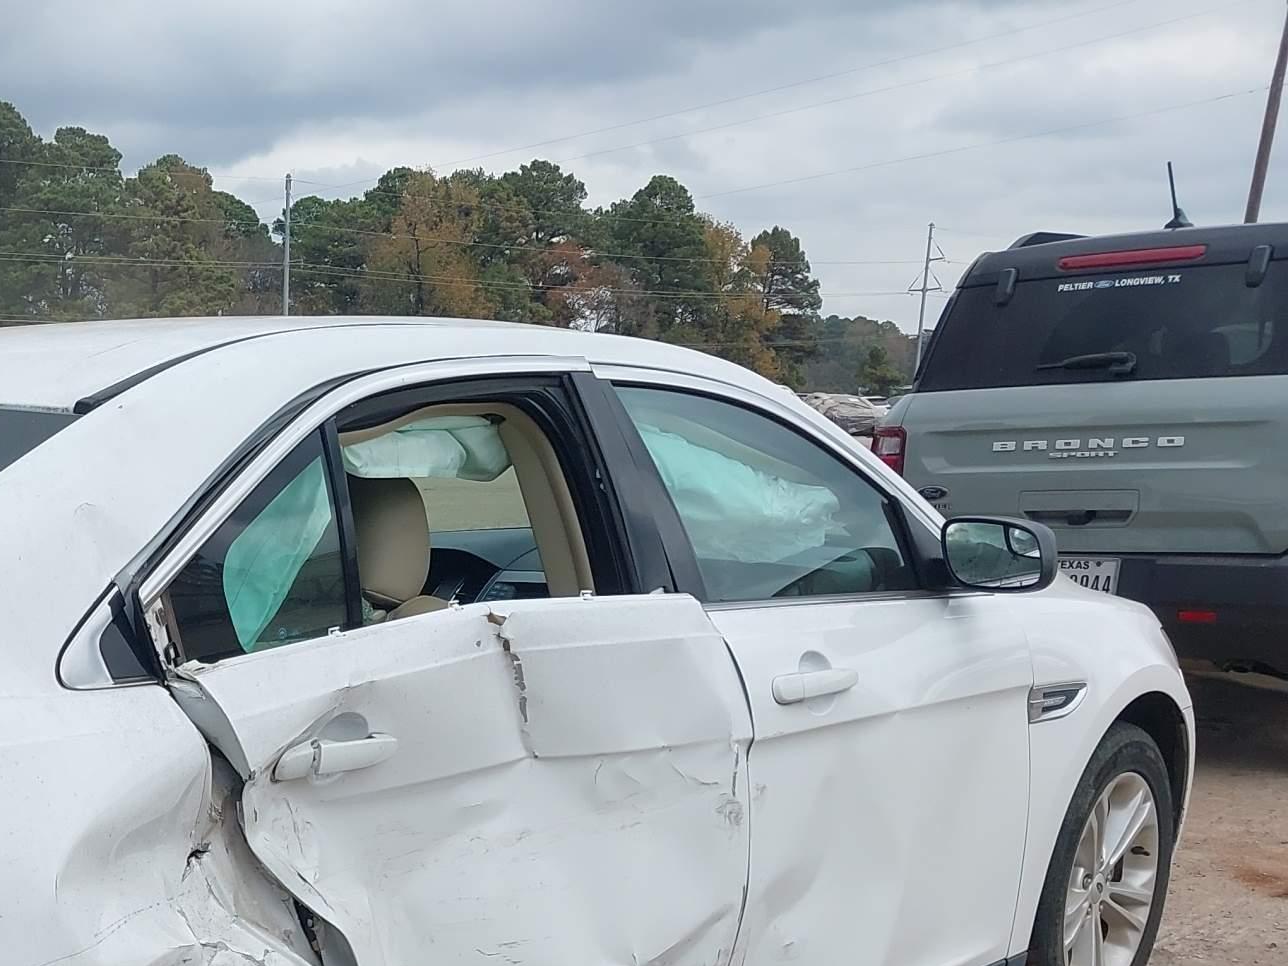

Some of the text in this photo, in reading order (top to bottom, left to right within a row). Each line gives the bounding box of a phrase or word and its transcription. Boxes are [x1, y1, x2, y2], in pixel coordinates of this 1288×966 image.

[1057, 281, 1094, 292] PELTIER
[1114, 275, 1165, 287] LONGVIEW,
[1167, 274, 1182, 283] TX
[992, 436, 1185, 452] BRONCO
[1048, 451, 1119, 459] SPORT
[1057, 560, 1090, 570] EXAS
